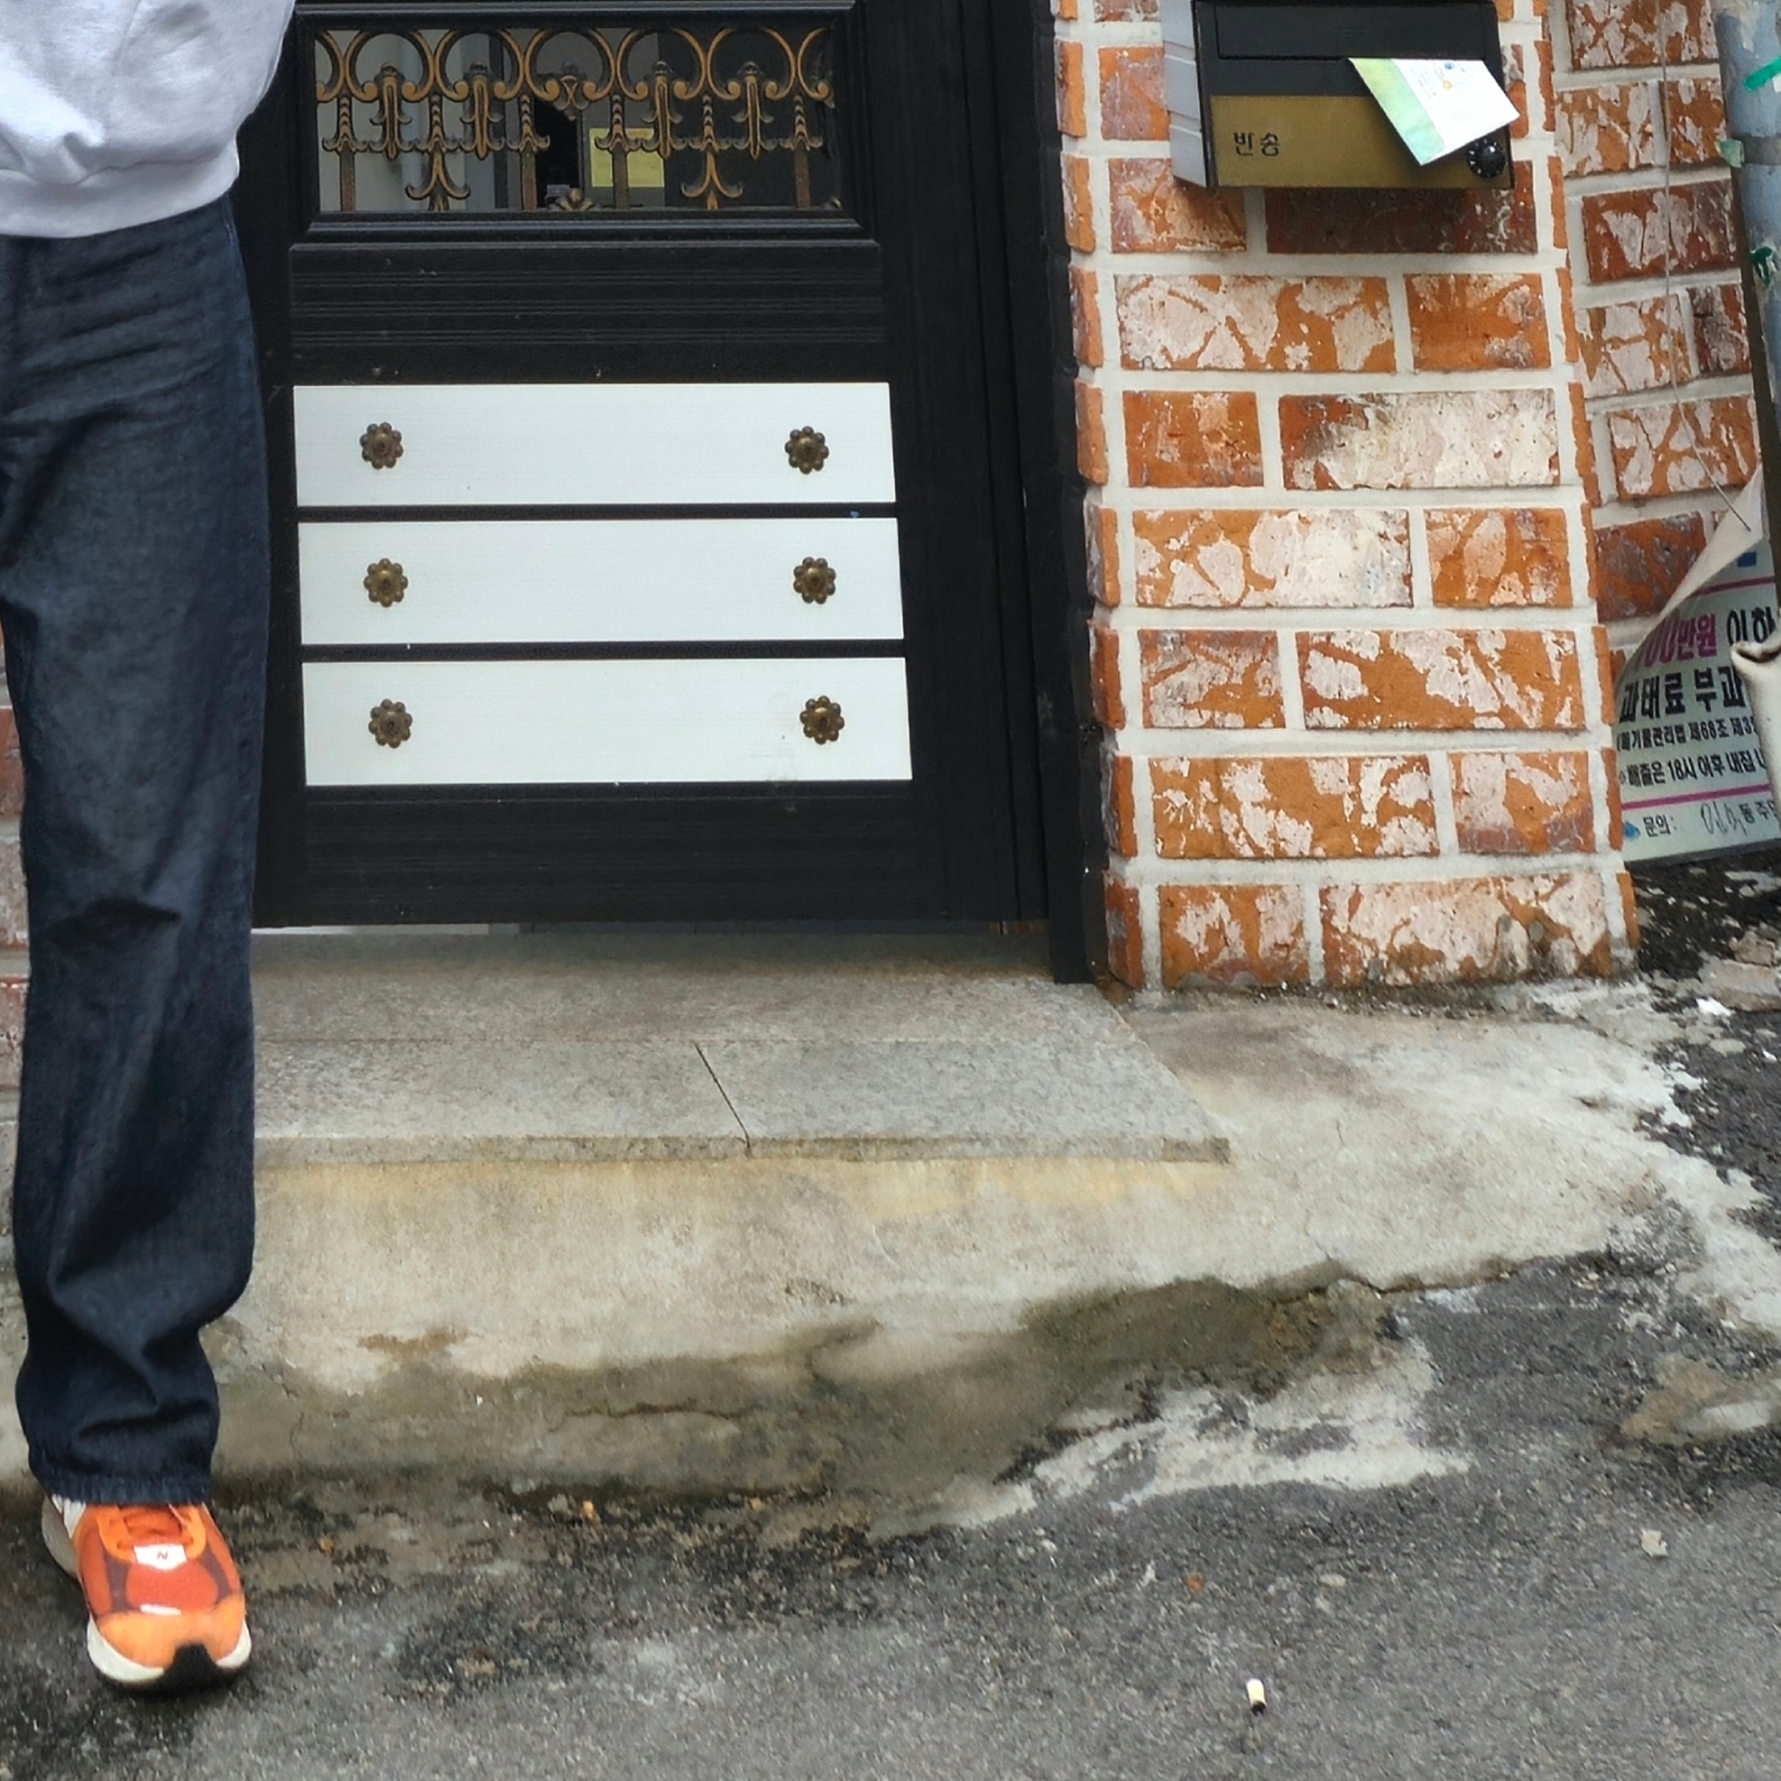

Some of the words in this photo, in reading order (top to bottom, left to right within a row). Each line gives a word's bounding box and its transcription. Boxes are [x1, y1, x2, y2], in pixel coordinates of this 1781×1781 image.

[1727, 607, 1776, 645] 이하
[1619, 672, 1686, 723] 과태료
[1694, 666, 1746, 712] 부과
[1688, 719, 1730, 742] 제68조
[1667, 756, 1698, 781] 18시
[1698, 753, 1725, 778] 이후
[1725, 749, 1757, 773] 내집
